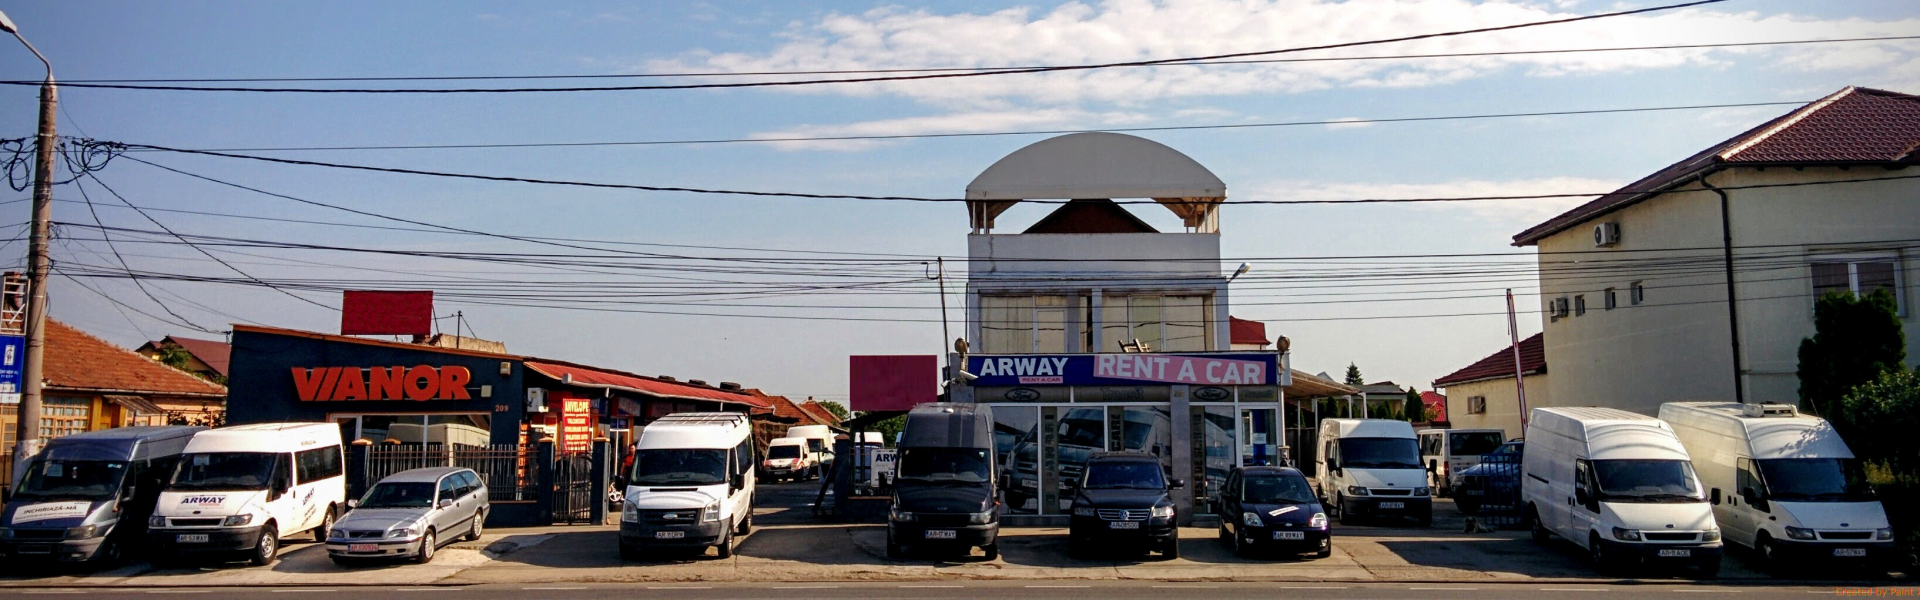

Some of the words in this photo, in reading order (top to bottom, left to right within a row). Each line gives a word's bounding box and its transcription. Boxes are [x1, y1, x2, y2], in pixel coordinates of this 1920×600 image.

[980, 357, 1069, 376] ARWAY
[1098, 355, 1170, 380] RENT
[1176, 362, 1197, 382] A
[1205, 361, 1262, 384] CAR
[291, 364, 472, 402] VIANOR
[494, 404, 509, 412] 209
[181, 496, 225, 504] ARWAY
